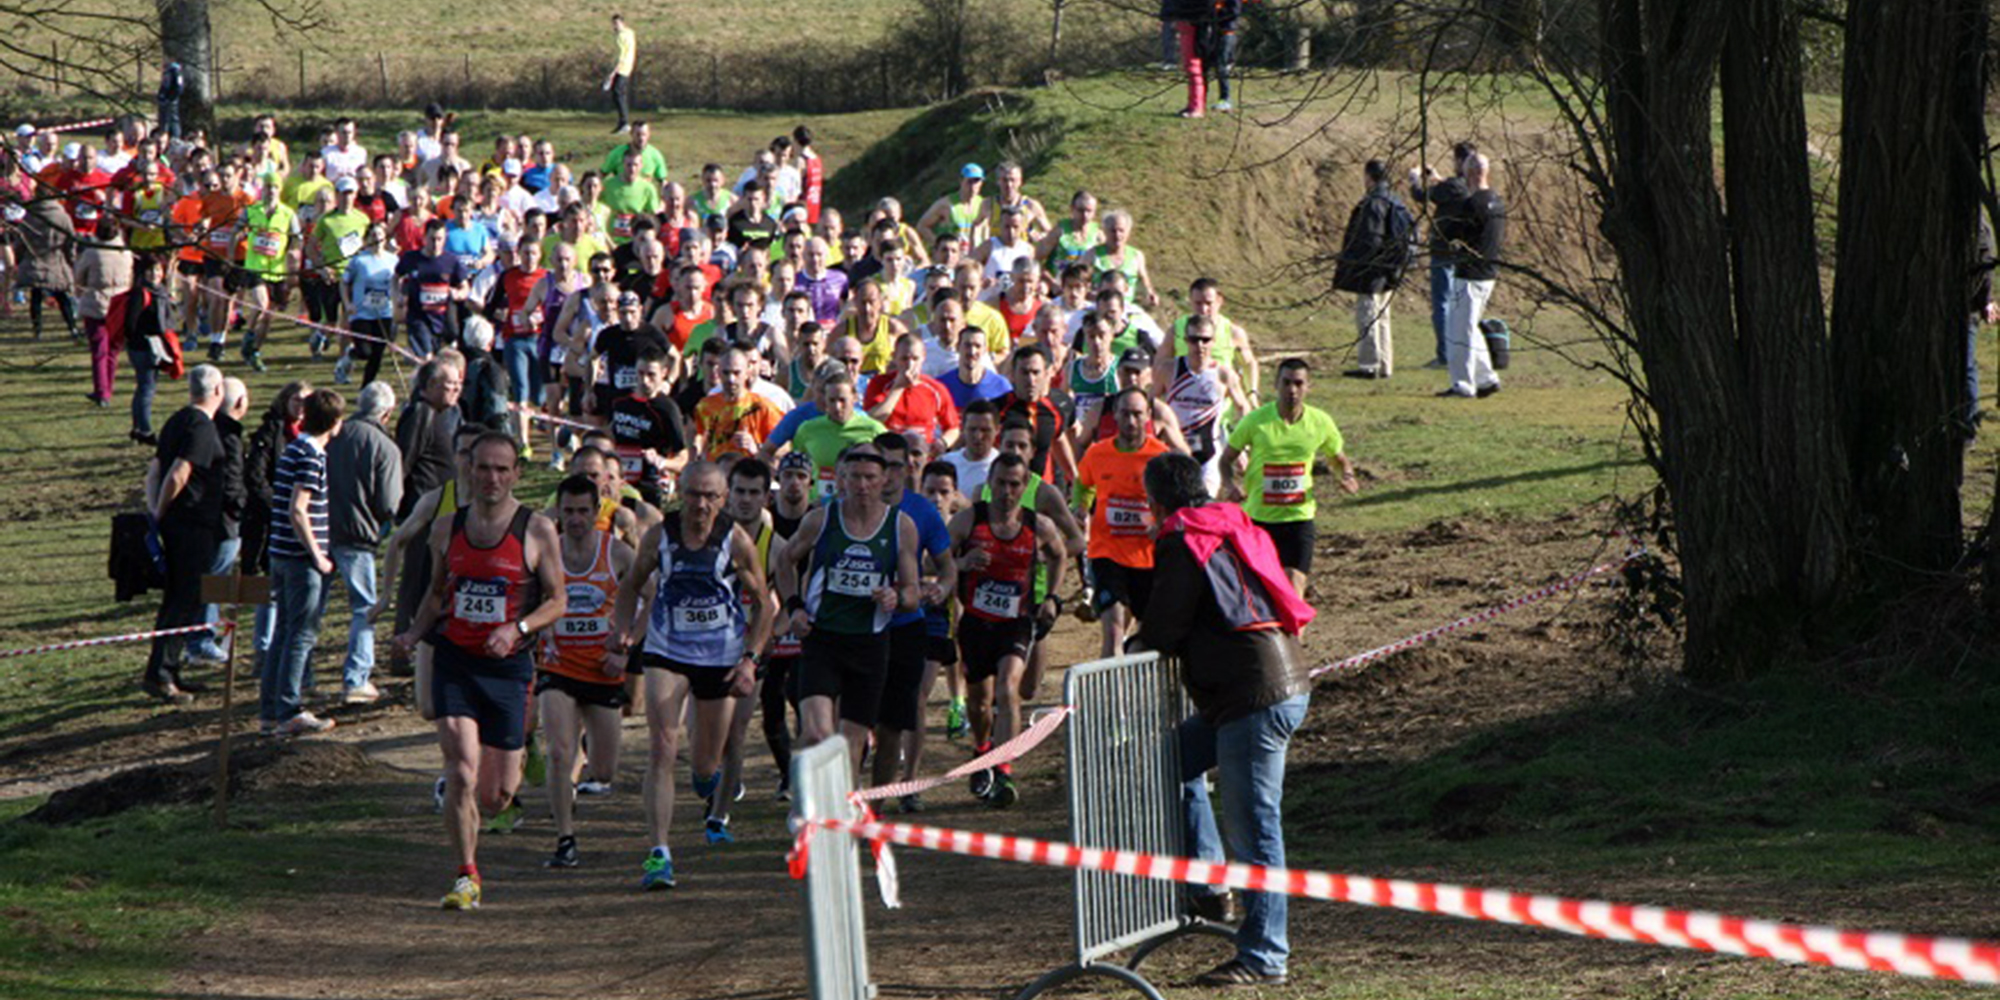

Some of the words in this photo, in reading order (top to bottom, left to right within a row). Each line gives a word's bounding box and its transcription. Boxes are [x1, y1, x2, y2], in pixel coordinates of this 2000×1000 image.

[1271, 479, 1299, 490] 803
[1113, 510, 1142, 523] 825
[840, 572, 871, 589] 254
[463, 596, 495, 614] 245
[982, 595, 1011, 611] 246
[685, 609, 719, 624] 368
[565, 621, 599, 633] 828
